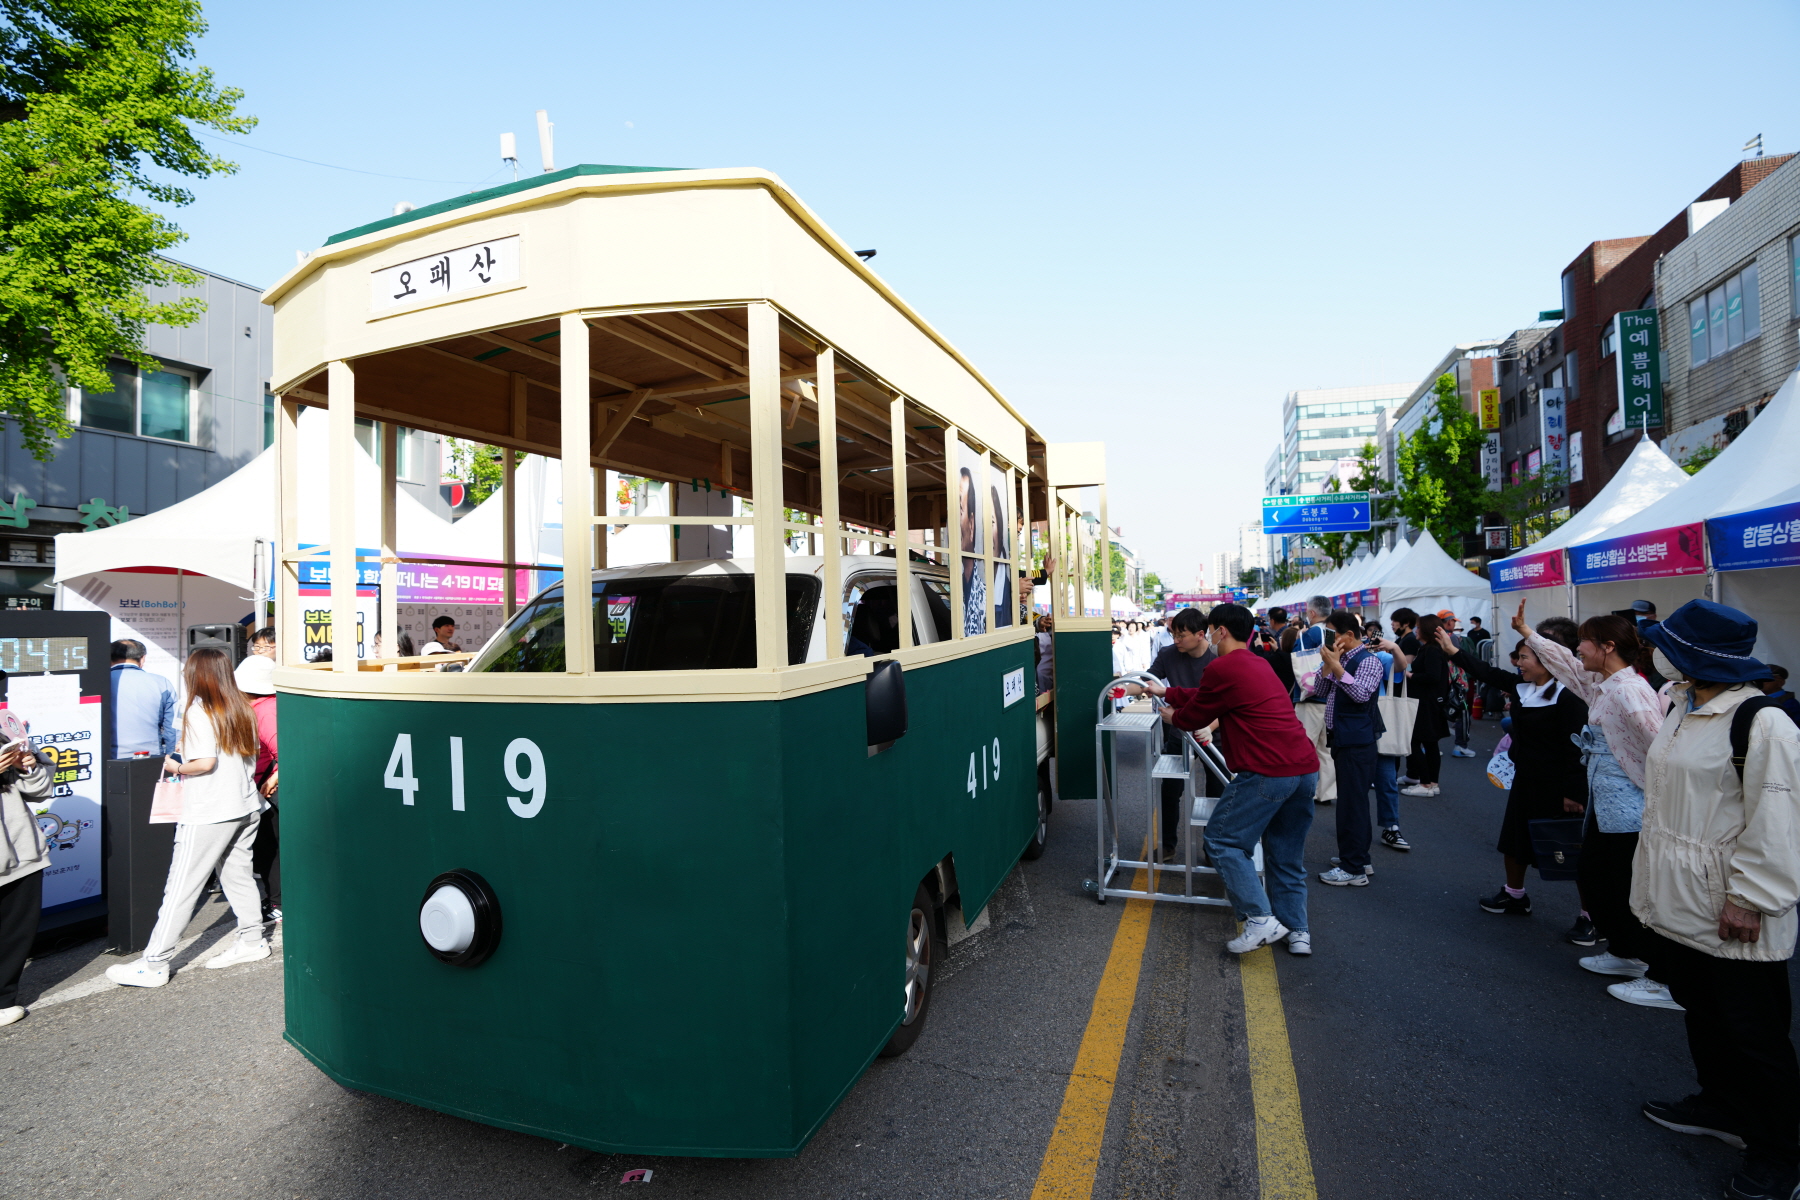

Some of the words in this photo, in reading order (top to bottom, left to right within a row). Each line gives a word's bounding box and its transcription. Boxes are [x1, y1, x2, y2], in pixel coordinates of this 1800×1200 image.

[393, 246, 497, 300] 오패산
[1623, 315, 1654, 327] The
[1484, 394, 1495, 422] 전당포
[1546, 396, 1565, 451] 아리랑
[1485, 438, 1498, 455] 썸
[1301, 507, 1328, 517] 도봉로
[1586, 550, 1626, 570] 합동상황실
[1627, 541, 1669, 565] 소방본부
[472, 575, 486, 591] 대
[43, 864, 80, 878] 부보훈지청
